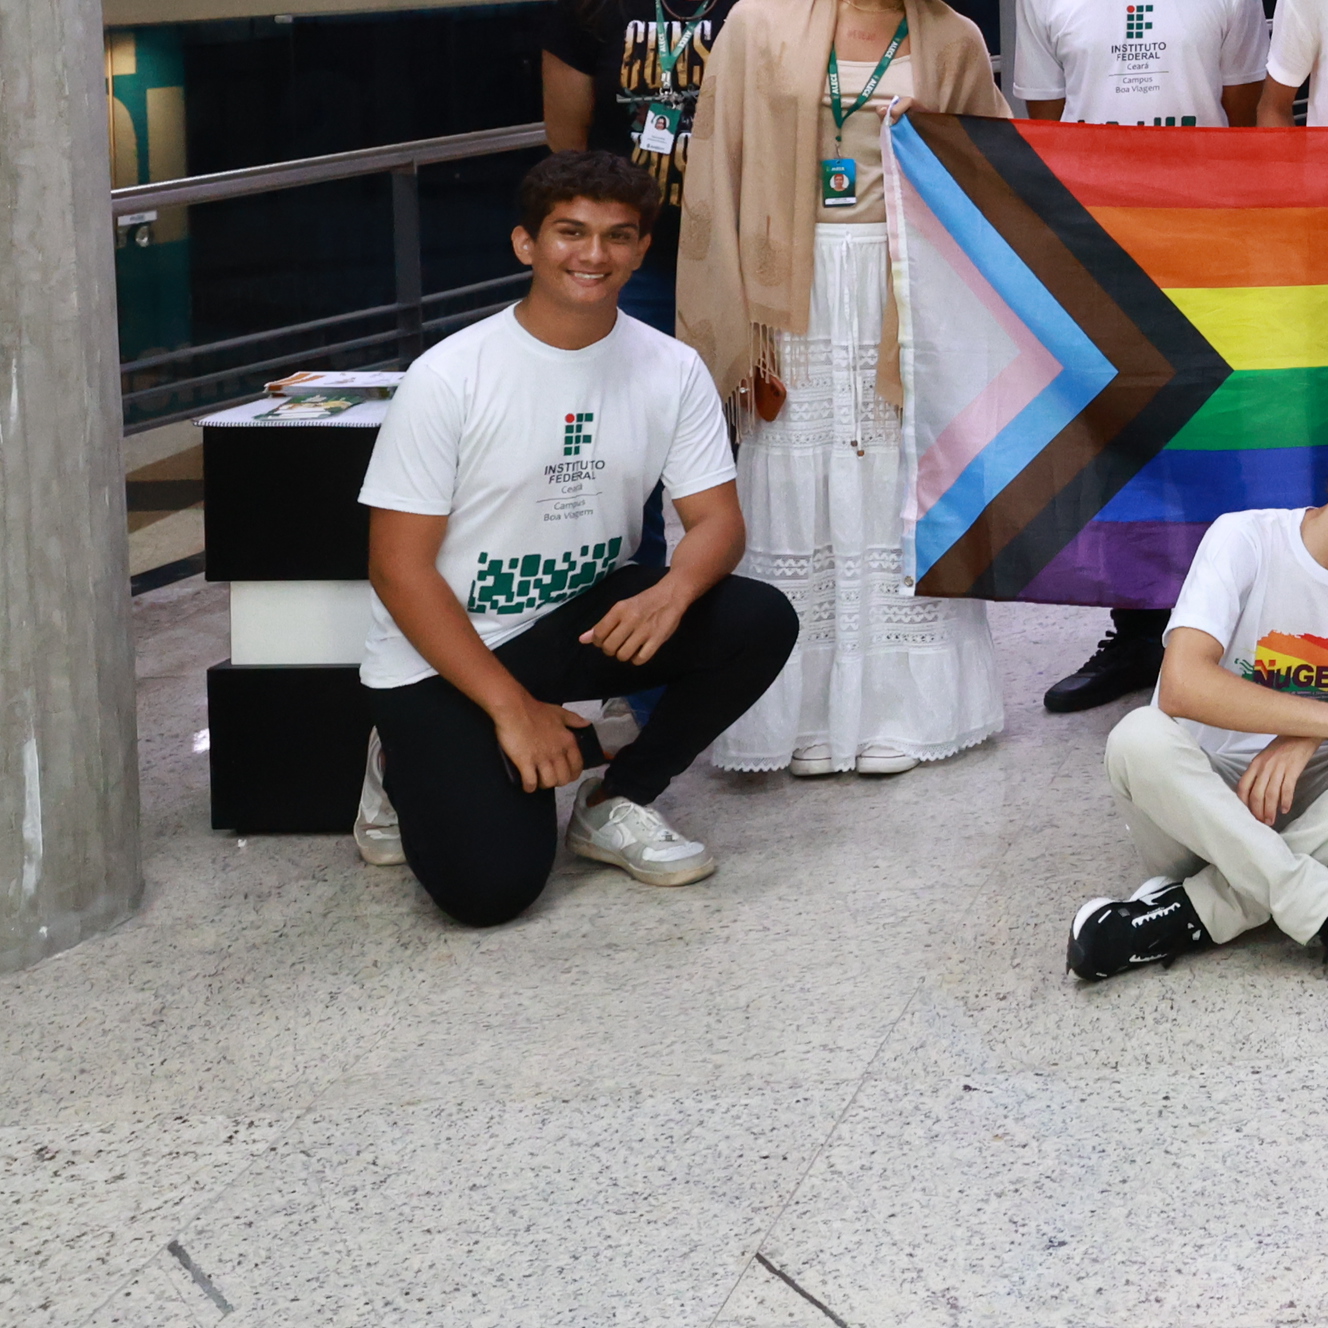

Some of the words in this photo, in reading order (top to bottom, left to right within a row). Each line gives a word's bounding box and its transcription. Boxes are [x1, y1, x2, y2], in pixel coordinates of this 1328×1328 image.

[1111, 42, 1167, 54] INSTITUTO
[1116, 52, 1161, 62] FEDERAL
[1122, 76, 1153, 84] Campus
[1115, 86, 1130, 94] Boa
[1131, 84, 1160, 93] Viagem
[544, 460, 606, 476] INSTITUTO
[548, 471, 596, 485] FEDERAL
[553, 499, 586, 511] Campus
[543, 513, 561, 522] Boa
